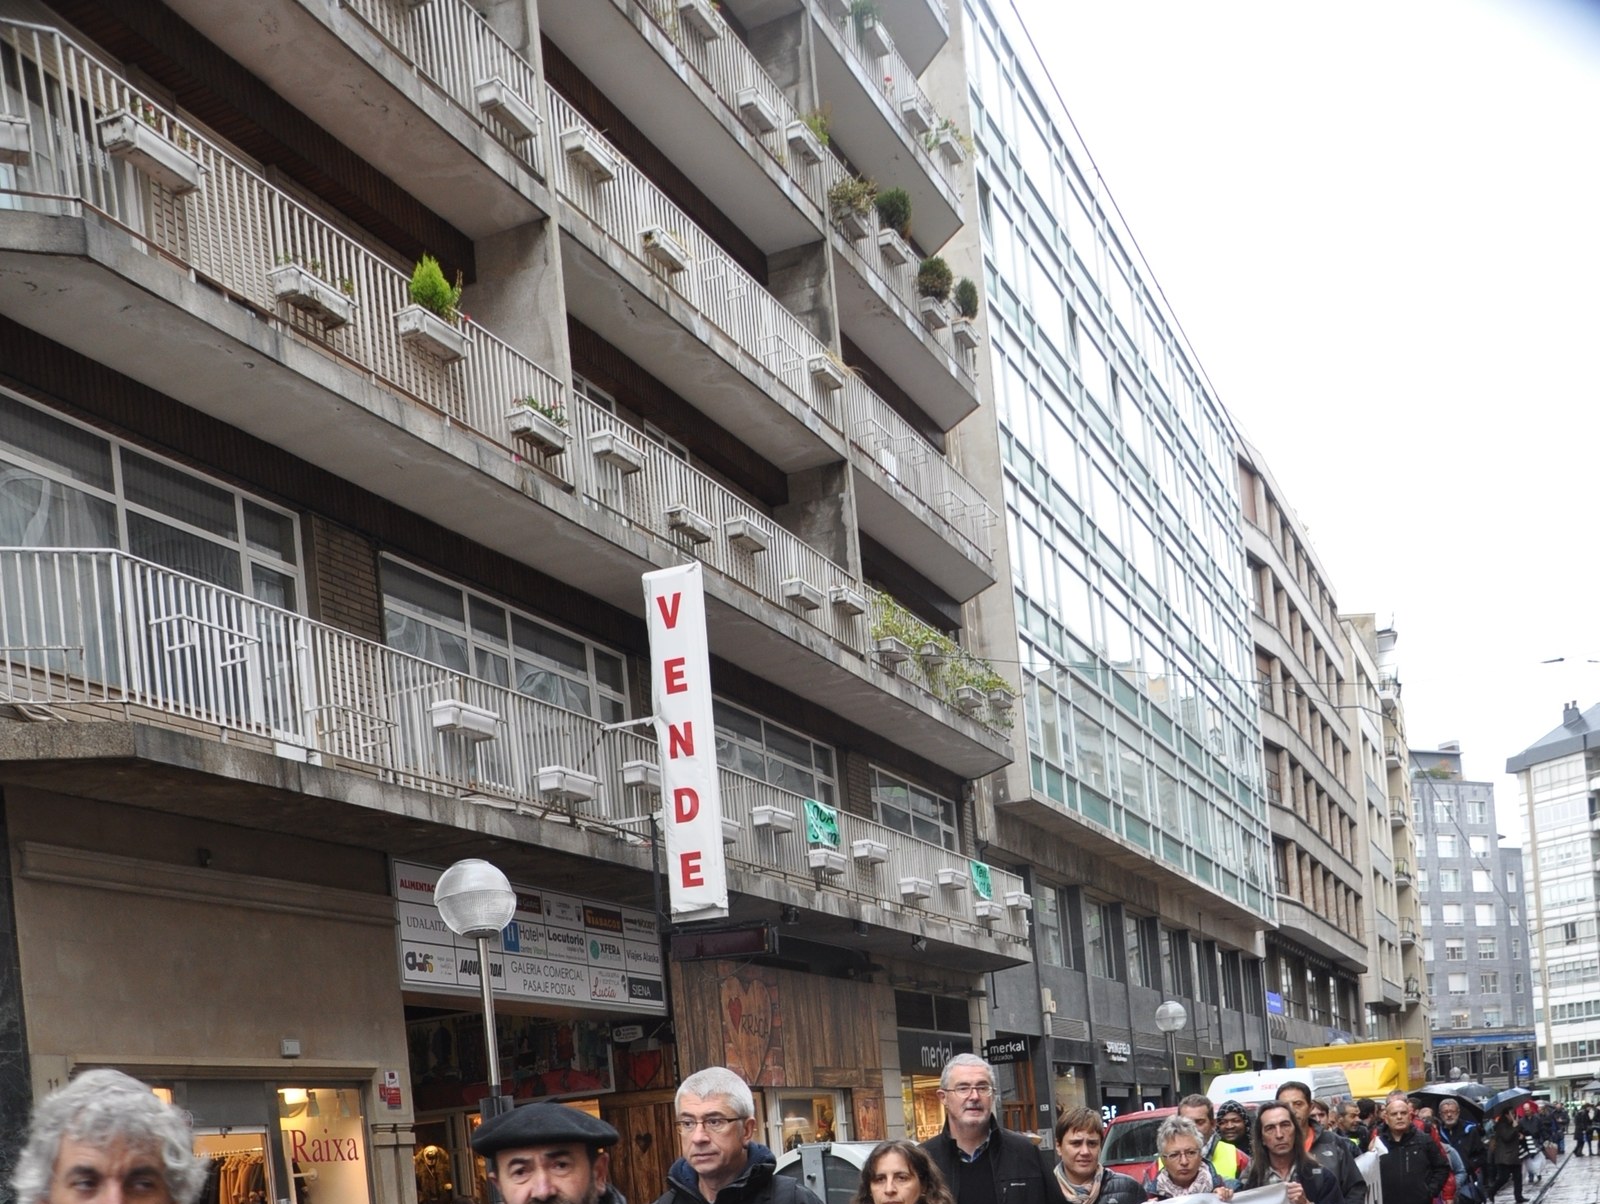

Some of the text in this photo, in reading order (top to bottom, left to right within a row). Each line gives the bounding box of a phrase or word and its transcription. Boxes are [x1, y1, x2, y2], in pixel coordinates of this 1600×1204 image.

[656, 592, 704, 888] VENDE
[400, 879, 437, 894] ALIMENTAC
[406, 916, 447, 932] UDALAITZ
[519, 925, 539, 942] Hotel
[547, 929, 584, 946] Locutorio
[600, 943, 620, 955] XFERA
[626, 950, 642, 962] Viajes
[511, 961, 584, 981] GALERIA COMERCIAL
[523, 979, 576, 996] PASAJE POSTAS
[632, 984, 652, 997] SIENA
[921, 1041, 953, 1068] merkal
[990, 1040, 1025, 1055] merkal
[1234, 1053, 1248, 1069] B
[1519, 1060, 1528, 1071] P
[290, 1128, 359, 1163] Raixa
